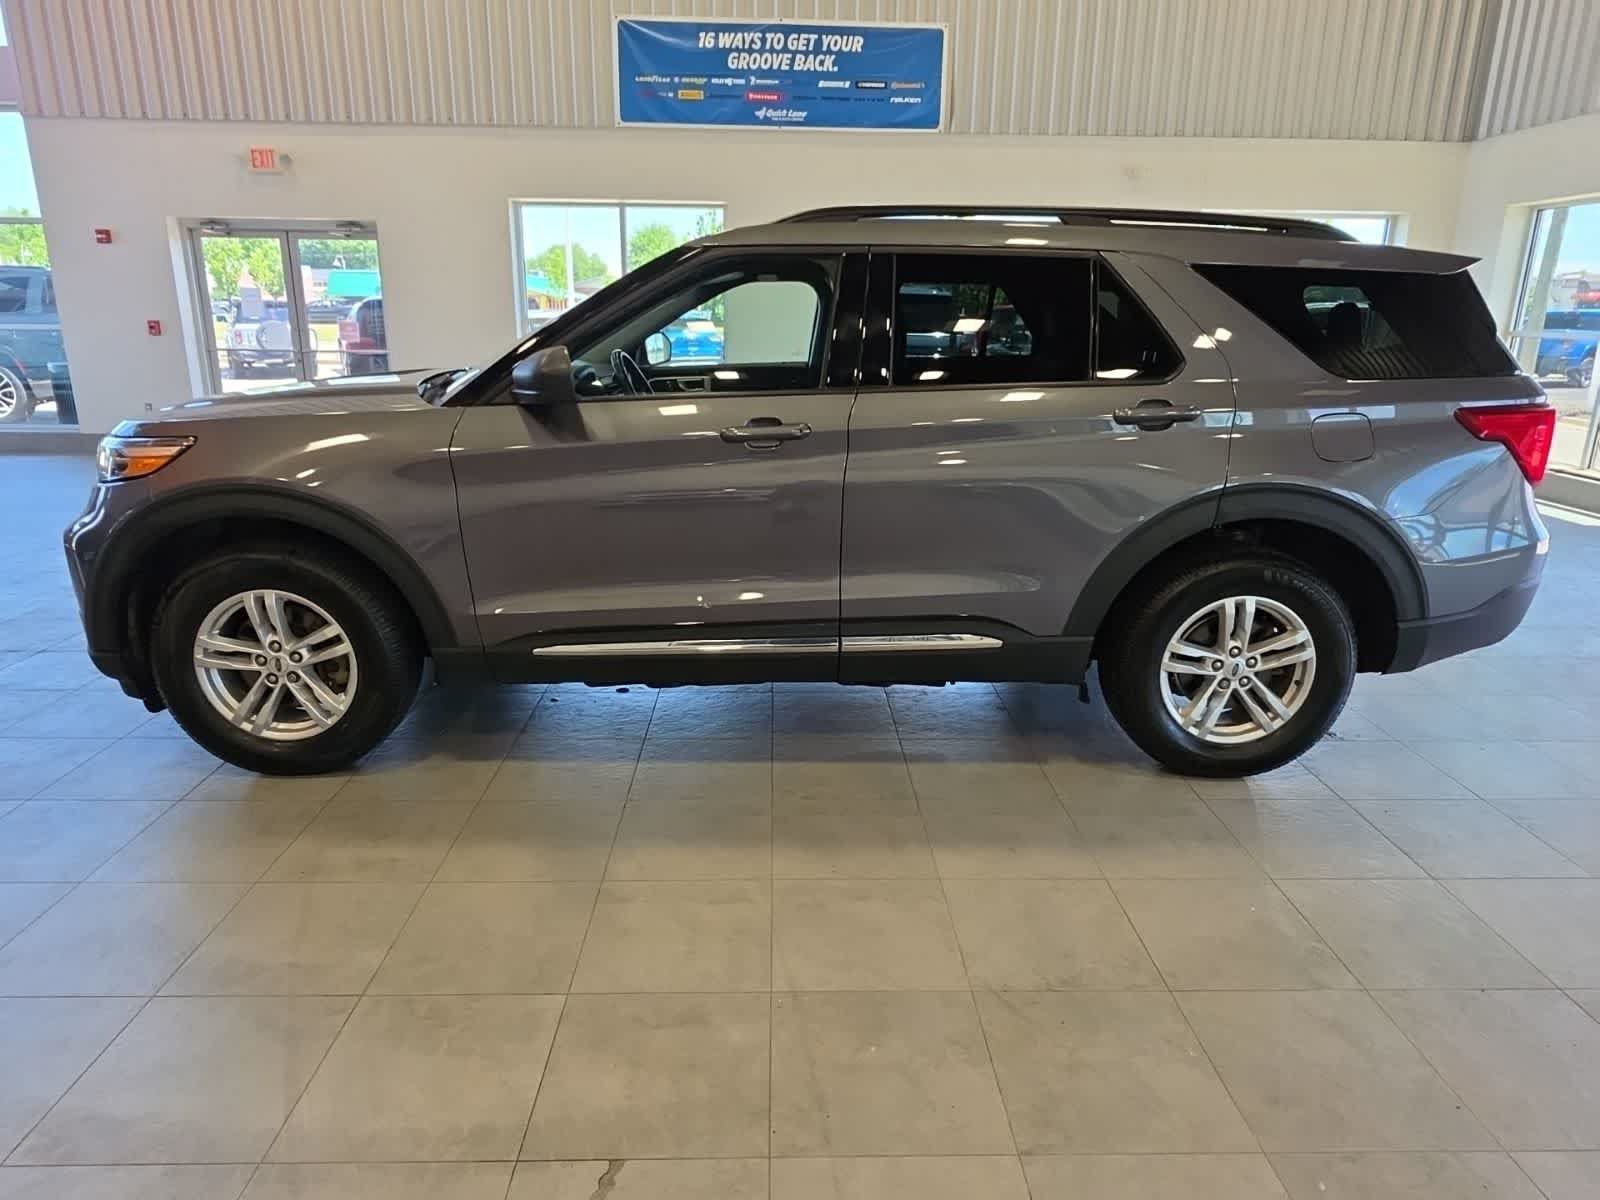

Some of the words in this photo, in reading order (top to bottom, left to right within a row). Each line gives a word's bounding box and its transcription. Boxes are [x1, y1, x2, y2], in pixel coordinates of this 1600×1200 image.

[698, 31, 716, 48] 16
[718, 32, 762, 49] WAYS
[765, 33, 785, 50] TO
[787, 33, 818, 51] GET
[821, 34, 864, 52] YOUR
[727, 52, 790, 70] GROOVE
[793, 54, 839, 72] BACK.
[250, 149, 275, 169] EXIT
